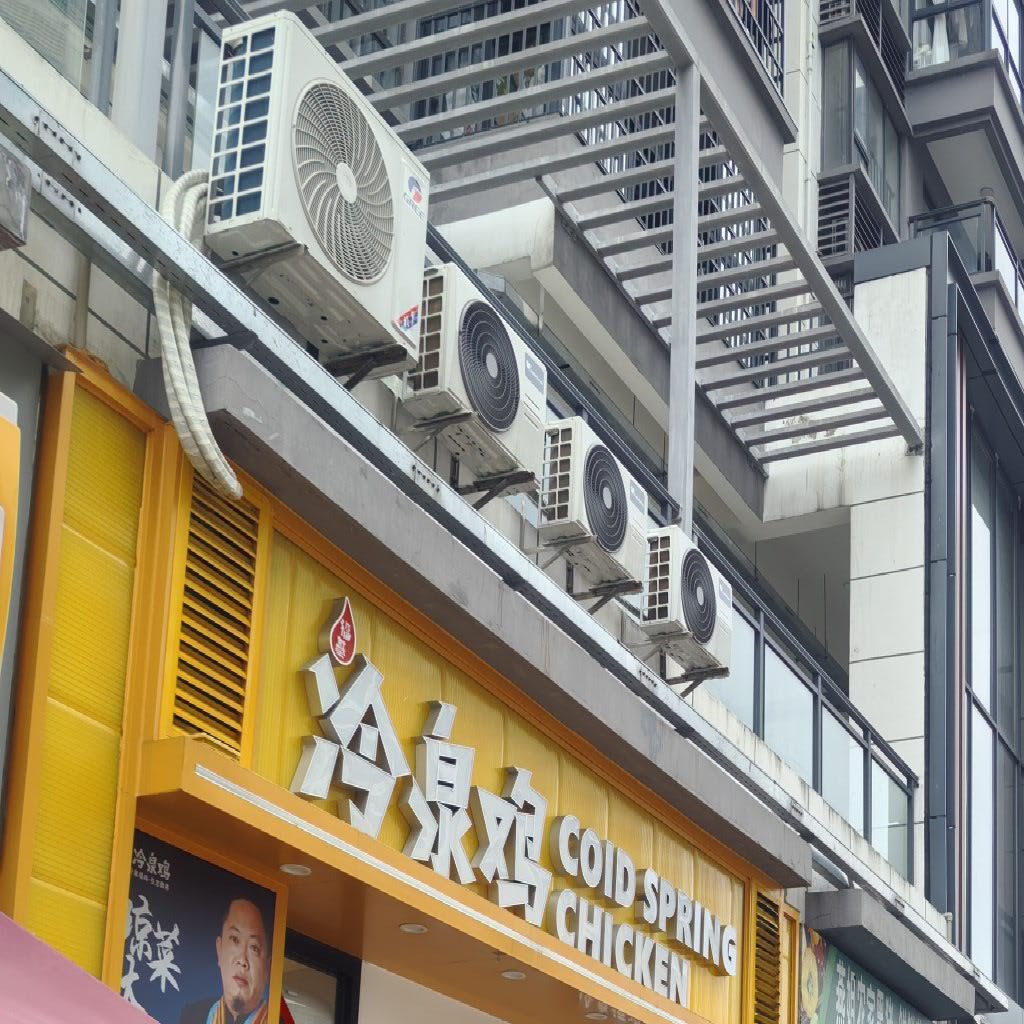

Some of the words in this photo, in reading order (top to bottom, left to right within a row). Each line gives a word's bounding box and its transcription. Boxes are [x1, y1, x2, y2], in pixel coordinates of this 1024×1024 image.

[292, 654, 552, 926] 冷泉鸡
[556, 888, 691, 1009] CHICKEN
[643, 868, 737, 976] SPRING
